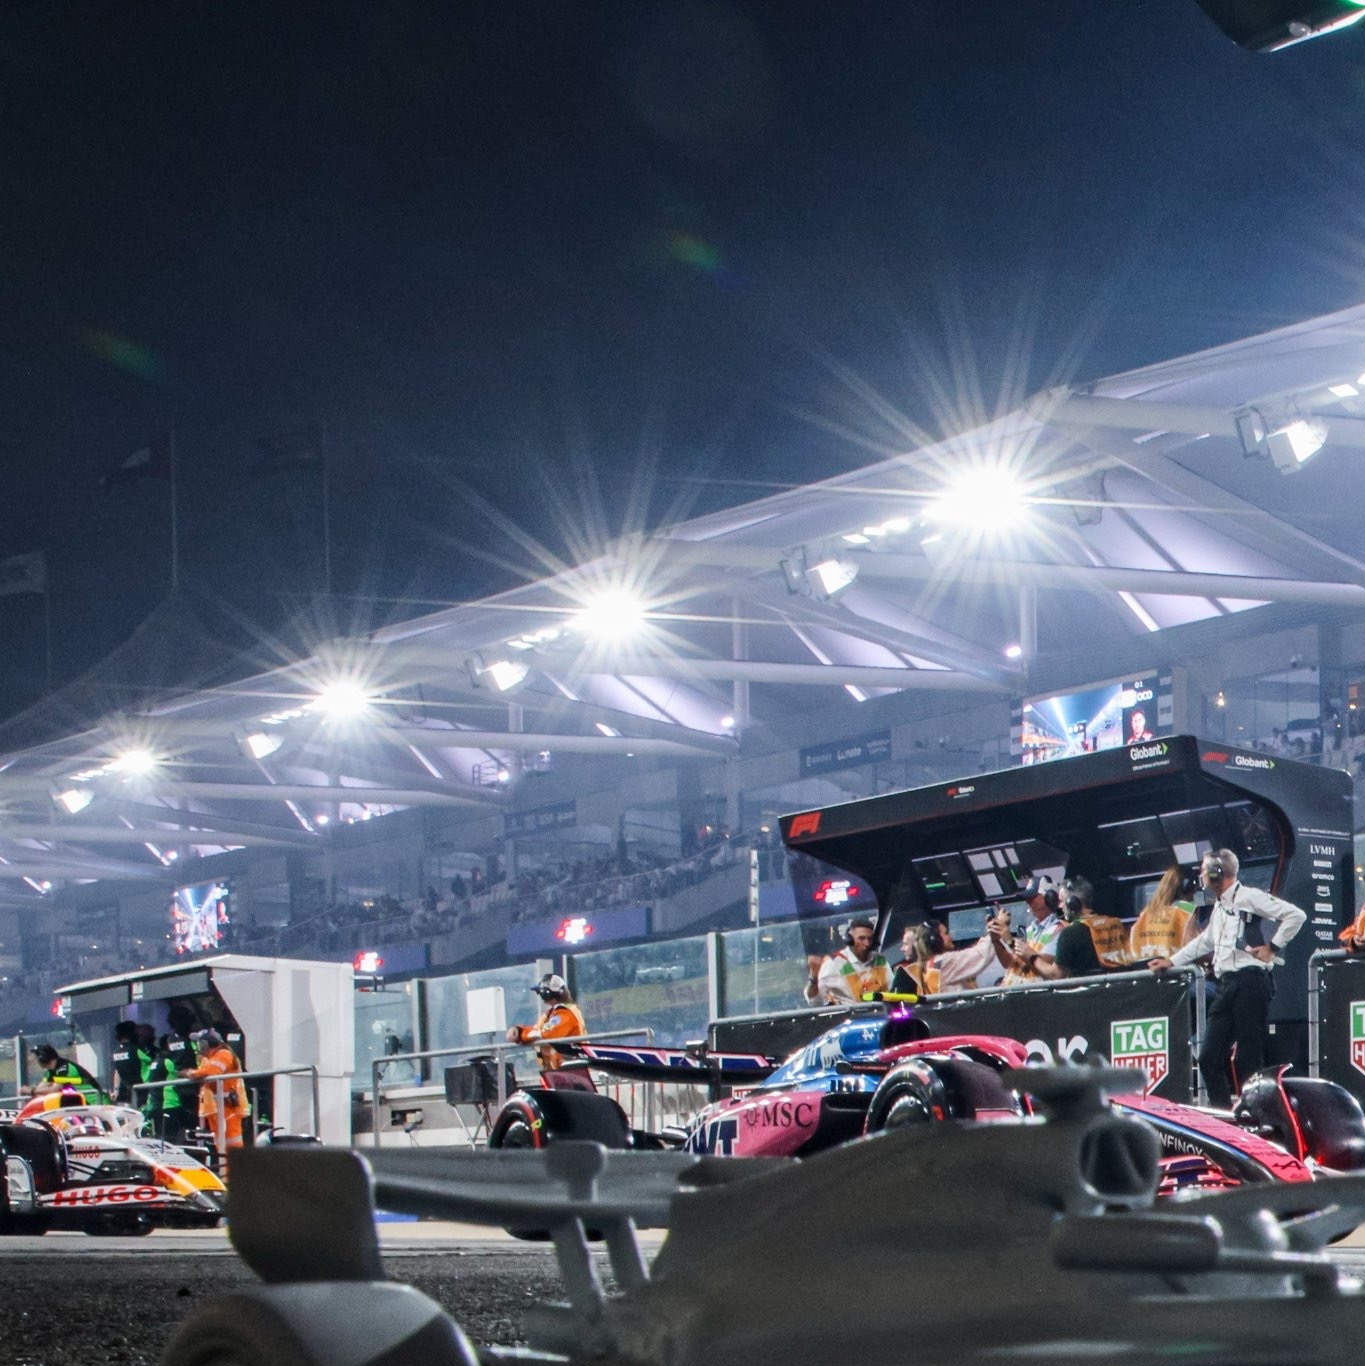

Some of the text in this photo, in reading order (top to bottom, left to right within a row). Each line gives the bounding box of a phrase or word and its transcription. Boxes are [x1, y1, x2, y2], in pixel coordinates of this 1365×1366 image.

[1130, 746, 1163, 761] Globant
[1235, 755, 1269, 769] Globant
[1310, 844, 1336, 856] LVMH
[1115, 1023, 1163, 1051] TAG
[761, 1102, 814, 1129] MSC
[53, 1186, 159, 1206] HUGO
